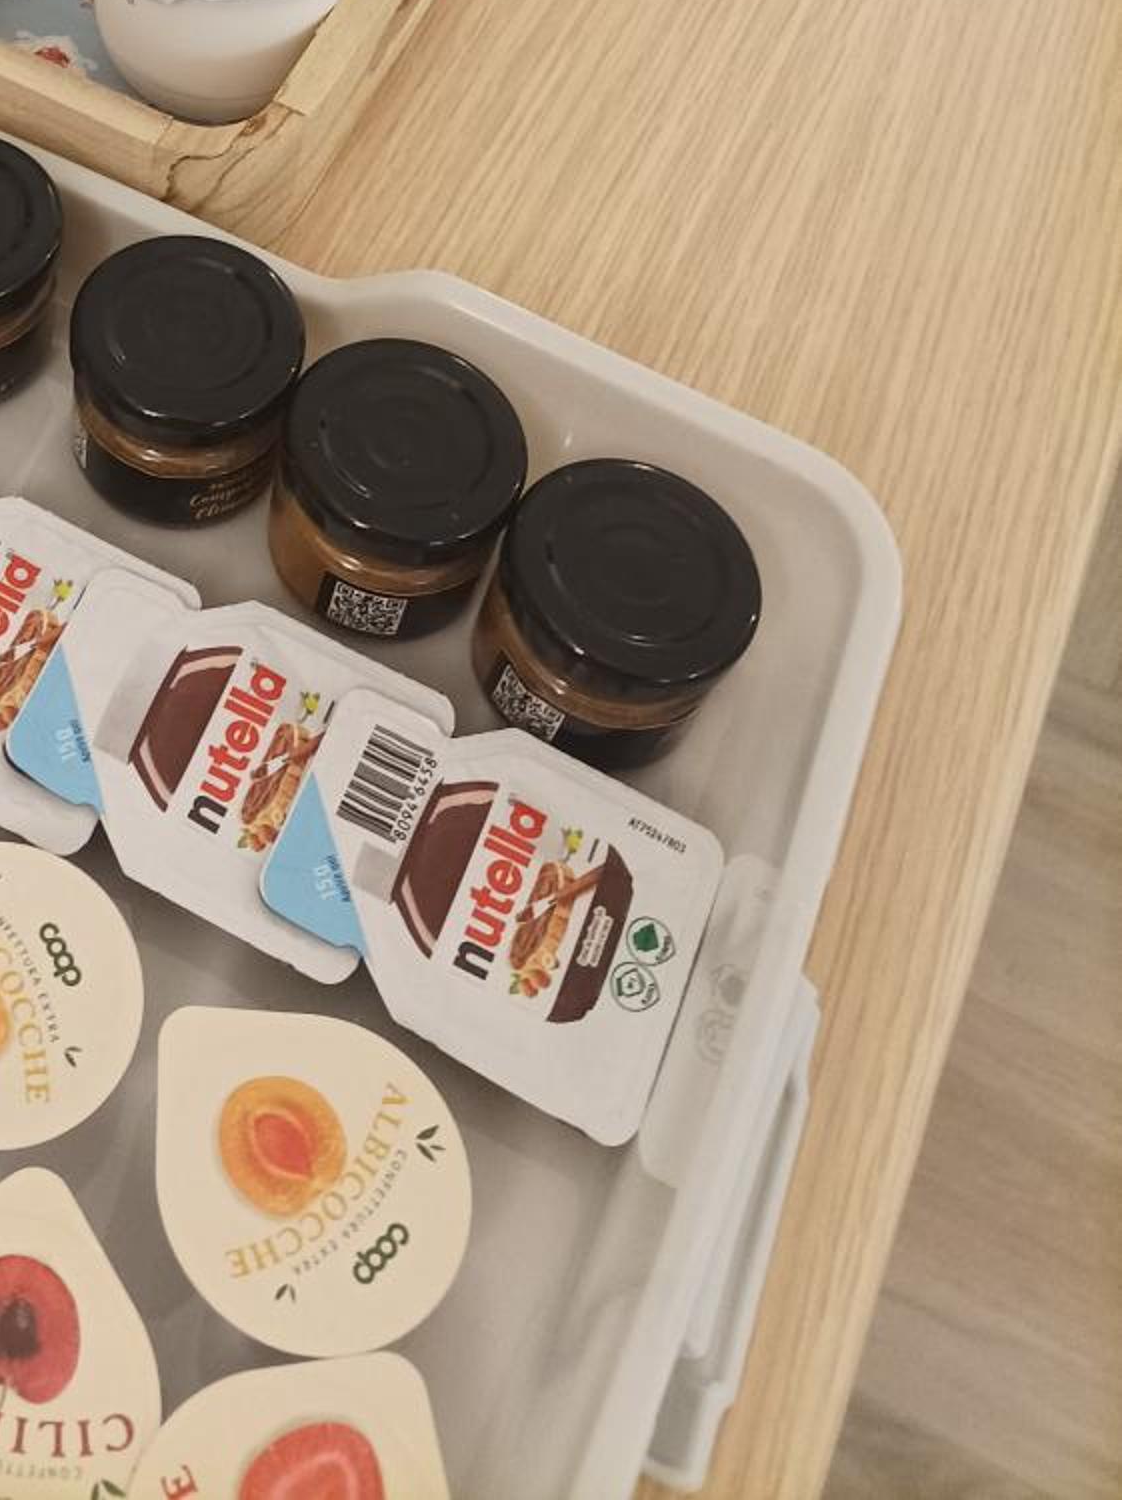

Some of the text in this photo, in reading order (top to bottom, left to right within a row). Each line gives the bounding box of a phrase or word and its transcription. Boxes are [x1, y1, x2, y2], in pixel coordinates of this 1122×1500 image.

[187, 663, 289, 835] nutella
[394, 803, 417, 840] 8094
[453, 800, 548, 981] nutella
[39, 922, 82, 987] coop
[37, 992, 62, 1043] EXTRA
[224, 1081, 410, 1280] ALBICOCCHE
[290, 1148, 408, 1278] CONFETTURA EXTRA
[351, 1223, 409, 1285] coop
